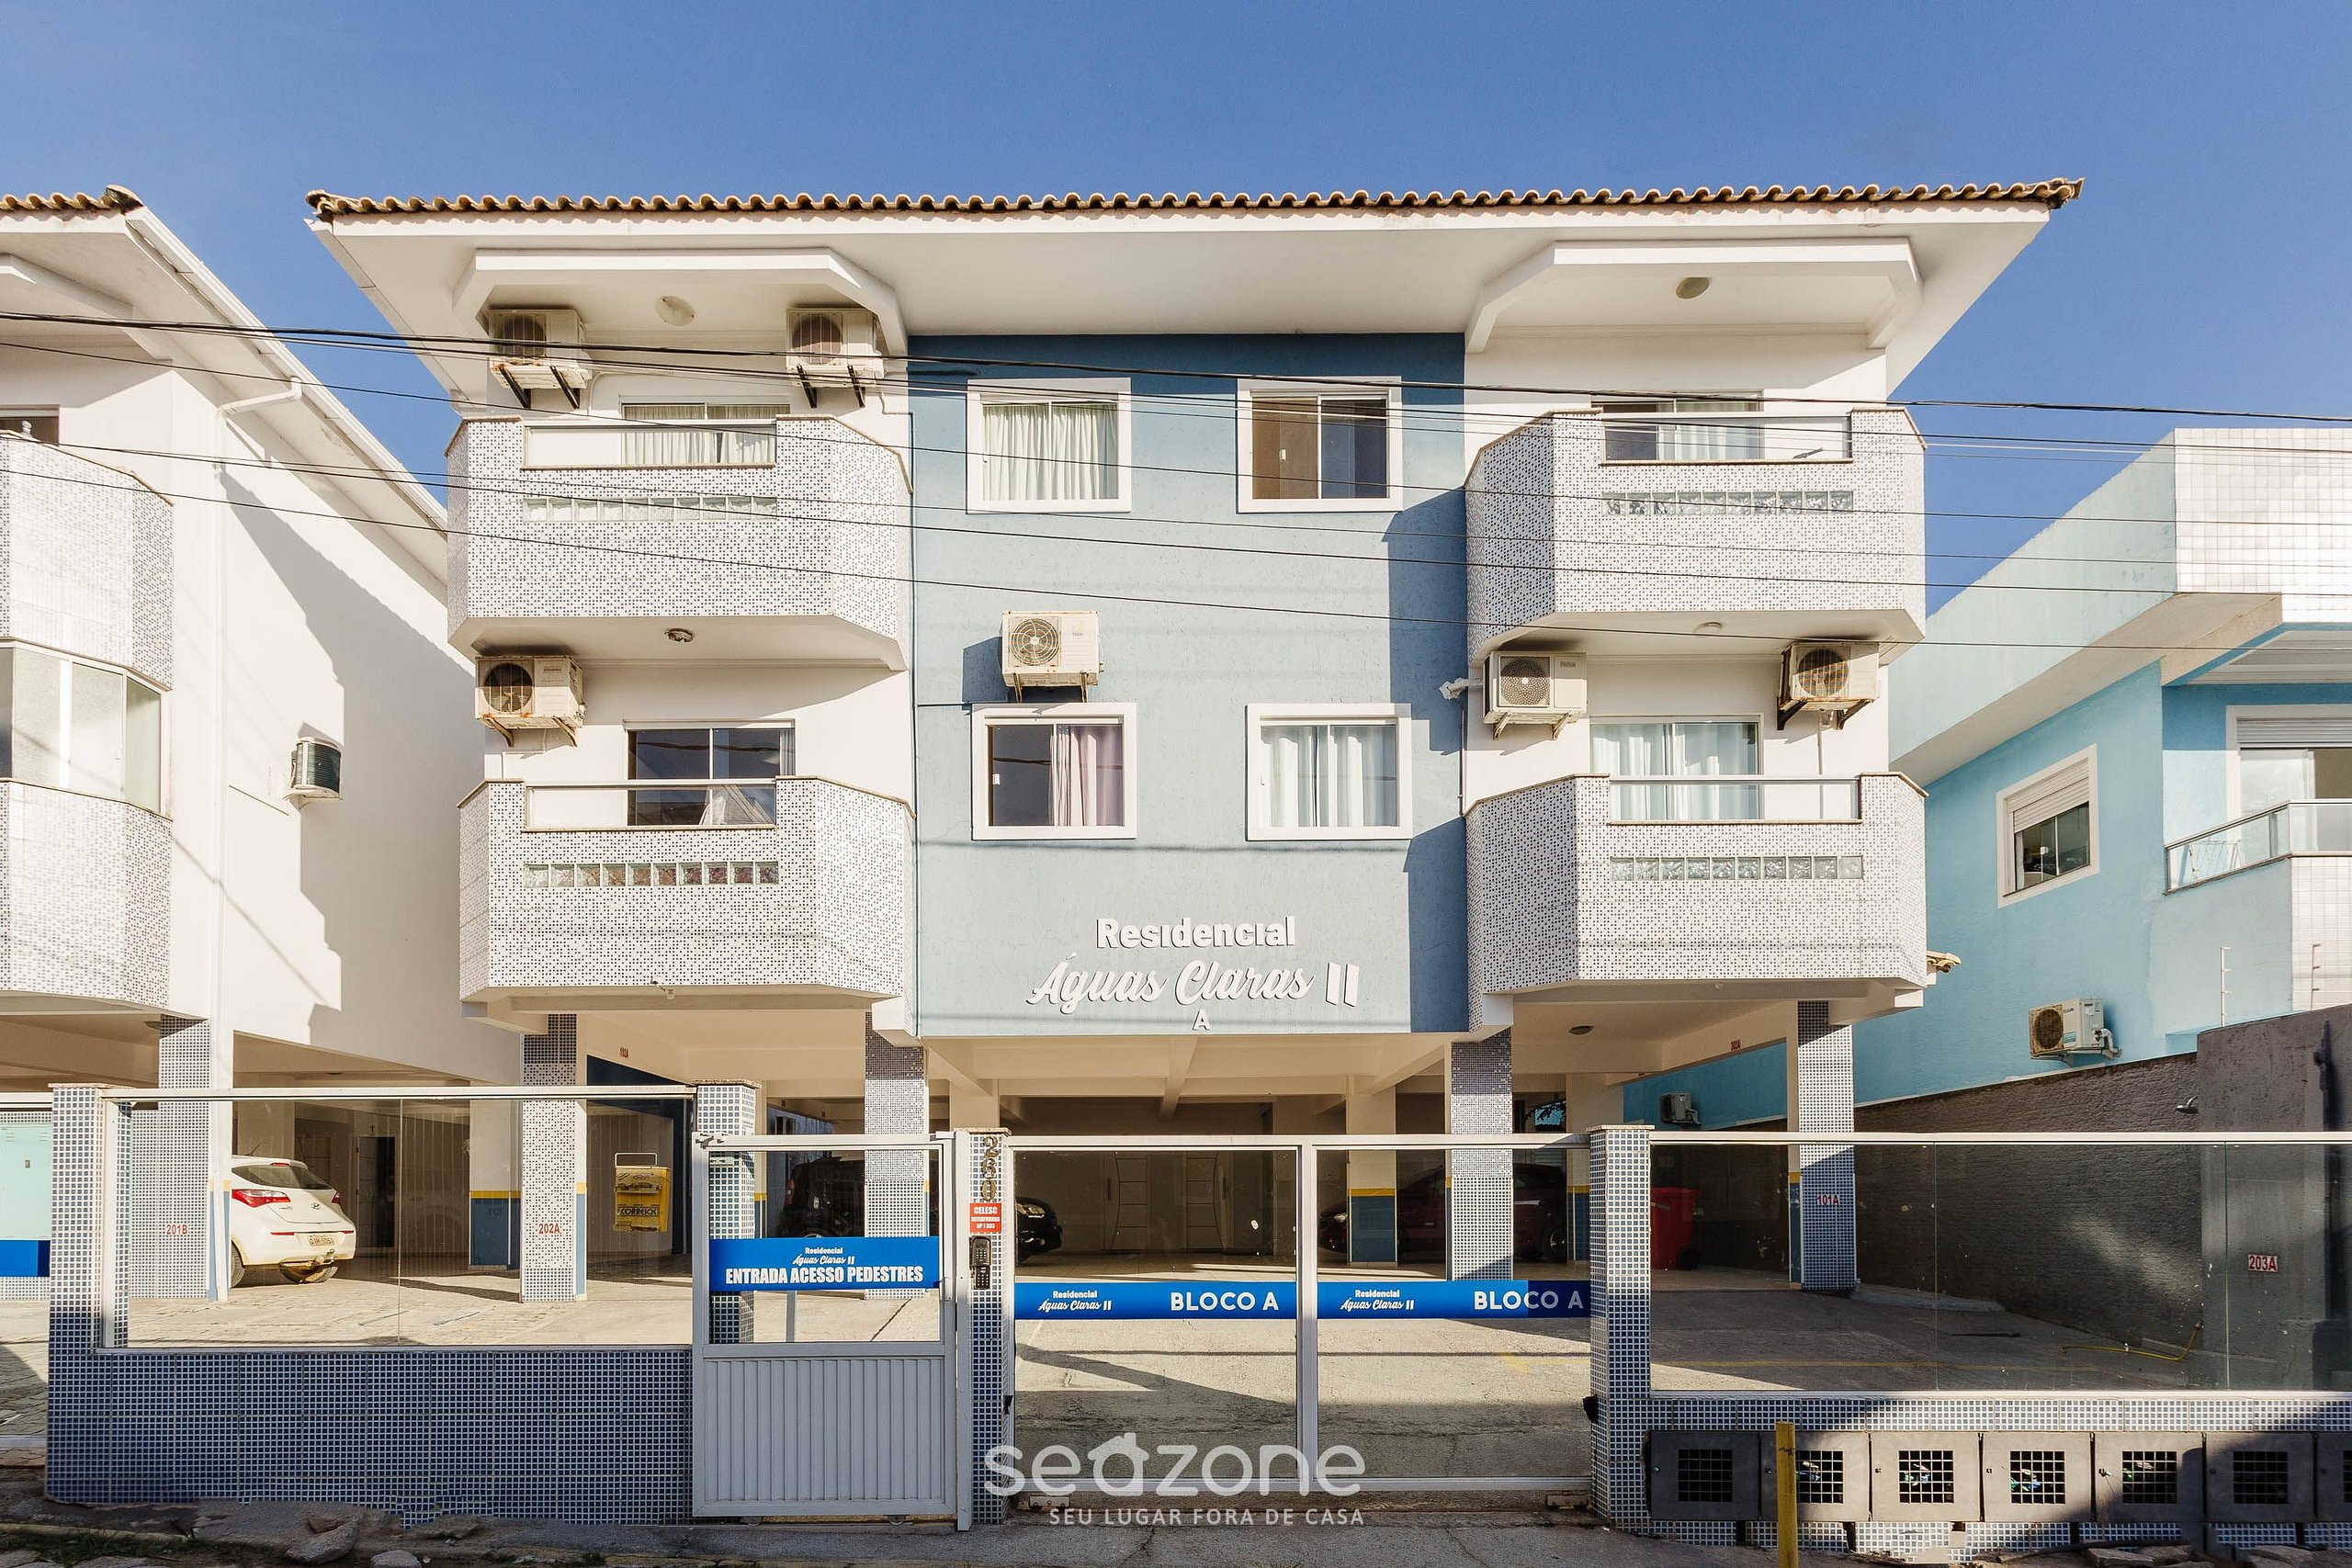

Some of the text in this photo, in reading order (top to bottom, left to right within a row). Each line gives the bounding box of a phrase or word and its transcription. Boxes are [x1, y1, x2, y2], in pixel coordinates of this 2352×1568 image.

[1096, 916, 1295, 948] Residencial
[1025, 952, 1360, 1014] Águas Claras II
[1192, 1009, 1211, 1031] A
[981, 1135, 999, 1202] 260
[1817, 1194, 1839, 1205] 101A
[620, 1207, 657, 1215] CORREIOS
[974, 1206, 998, 1214] CELESC
[166, 1224, 188, 1235] 201B
[538, 1223, 560, 1235] 202A
[805, 1247, 843, 1255] Residencial
[792, 1254, 820, 1266] Águas
[820, 1255, 847, 1265] Claras
[2249, 1256, 2277, 1270] 203A
[725, 1266, 923, 1284] ENTRADA ACESSO PEDESTRES
[1052, 1291, 1098, 1299] Residencial
[1354, 1290, 1400, 1298] Residencial
[1474, 1291, 1584, 1310] BLOCO A
[1038, 1298, 1069, 1312] Águas
[1070, 1300, 1102, 1311] Claras
[1170, 1292, 1279, 1312] BLOCO A
[1340, 1297, 1372, 1312] Águas
[1373, 1299, 1405, 1310] Claras
